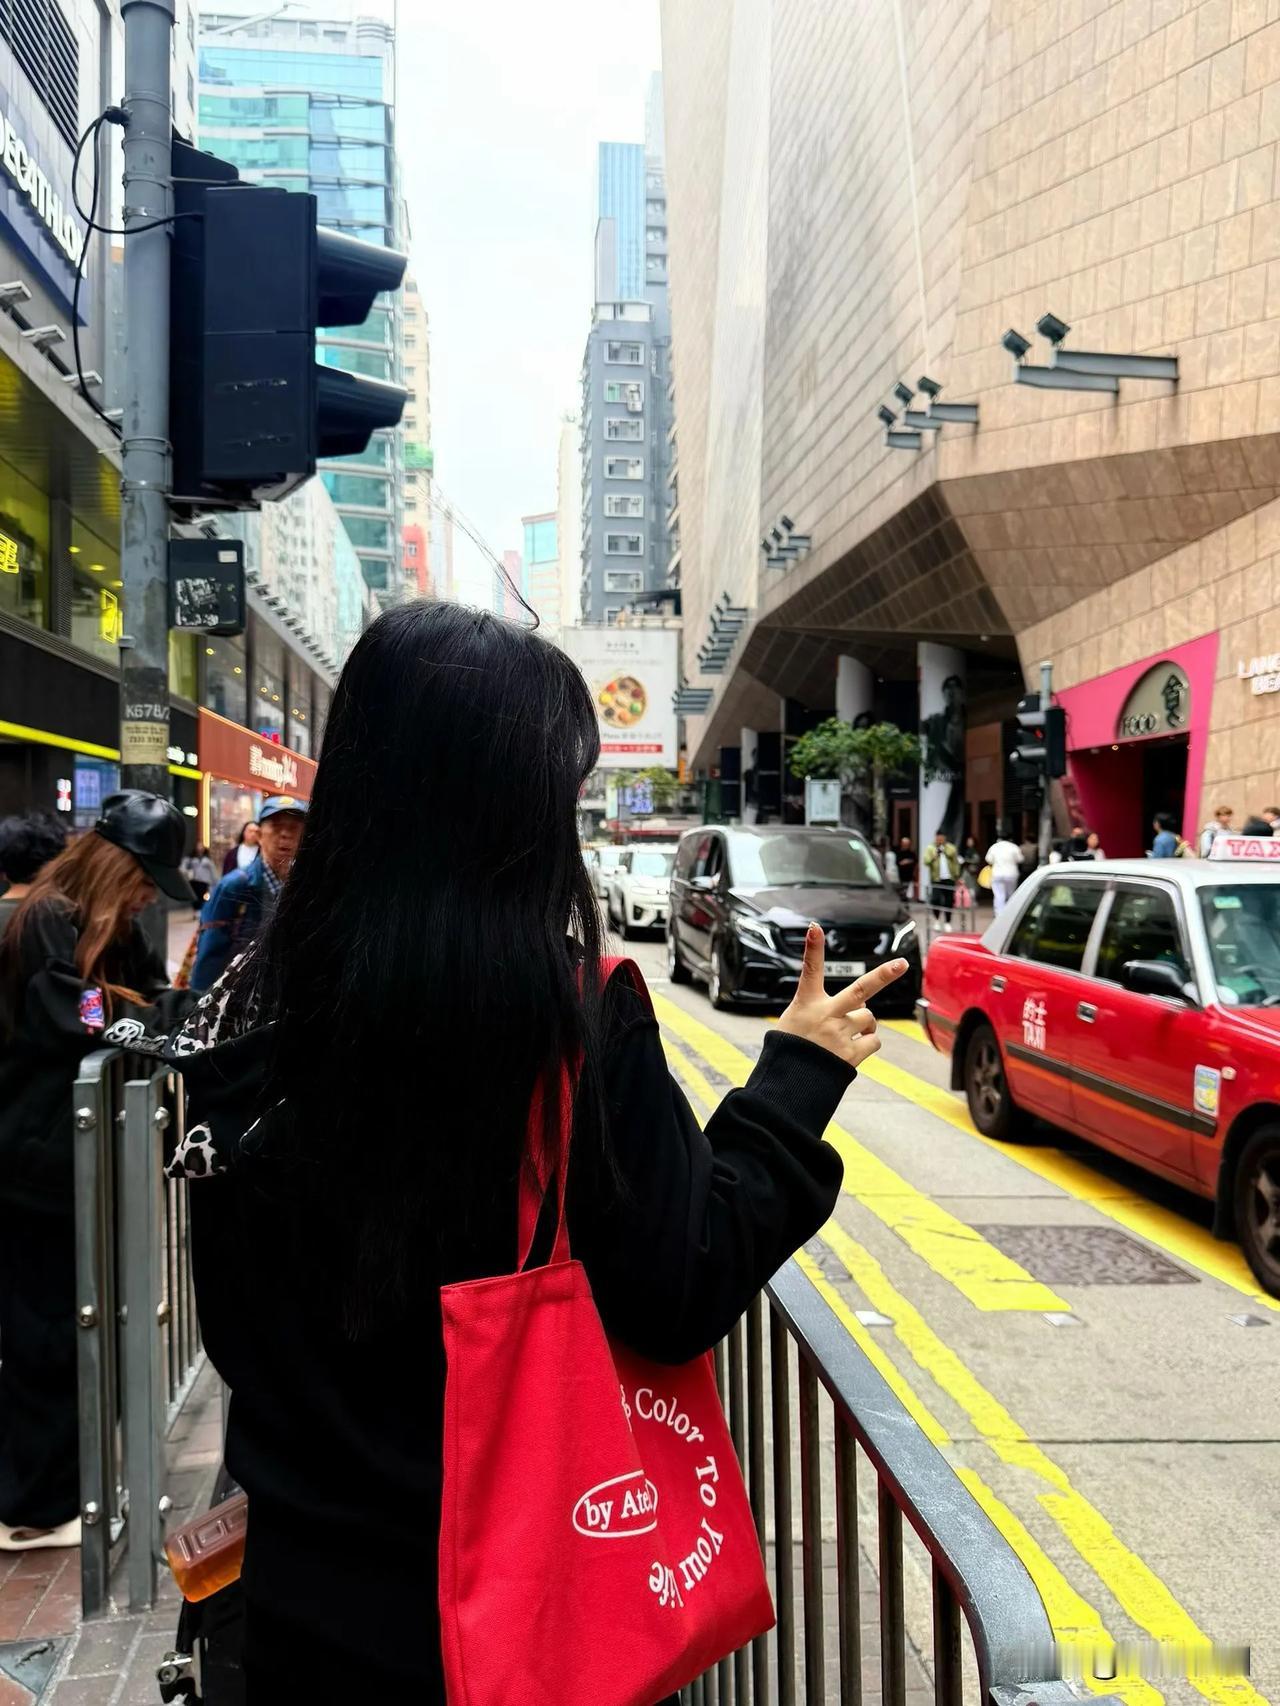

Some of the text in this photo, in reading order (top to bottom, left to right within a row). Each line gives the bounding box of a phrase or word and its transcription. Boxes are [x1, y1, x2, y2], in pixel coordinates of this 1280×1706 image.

[1123, 712, 1159, 736] FOOD
[1023, 997, 1048, 1025] 的士
[1022, 1020, 1047, 1051] TAXI
[635, 1388, 704, 1442] Color
[695, 1456, 719, 1508] To
[584, 1498, 613, 1531] by
[678, 1517, 724, 1591] Your
